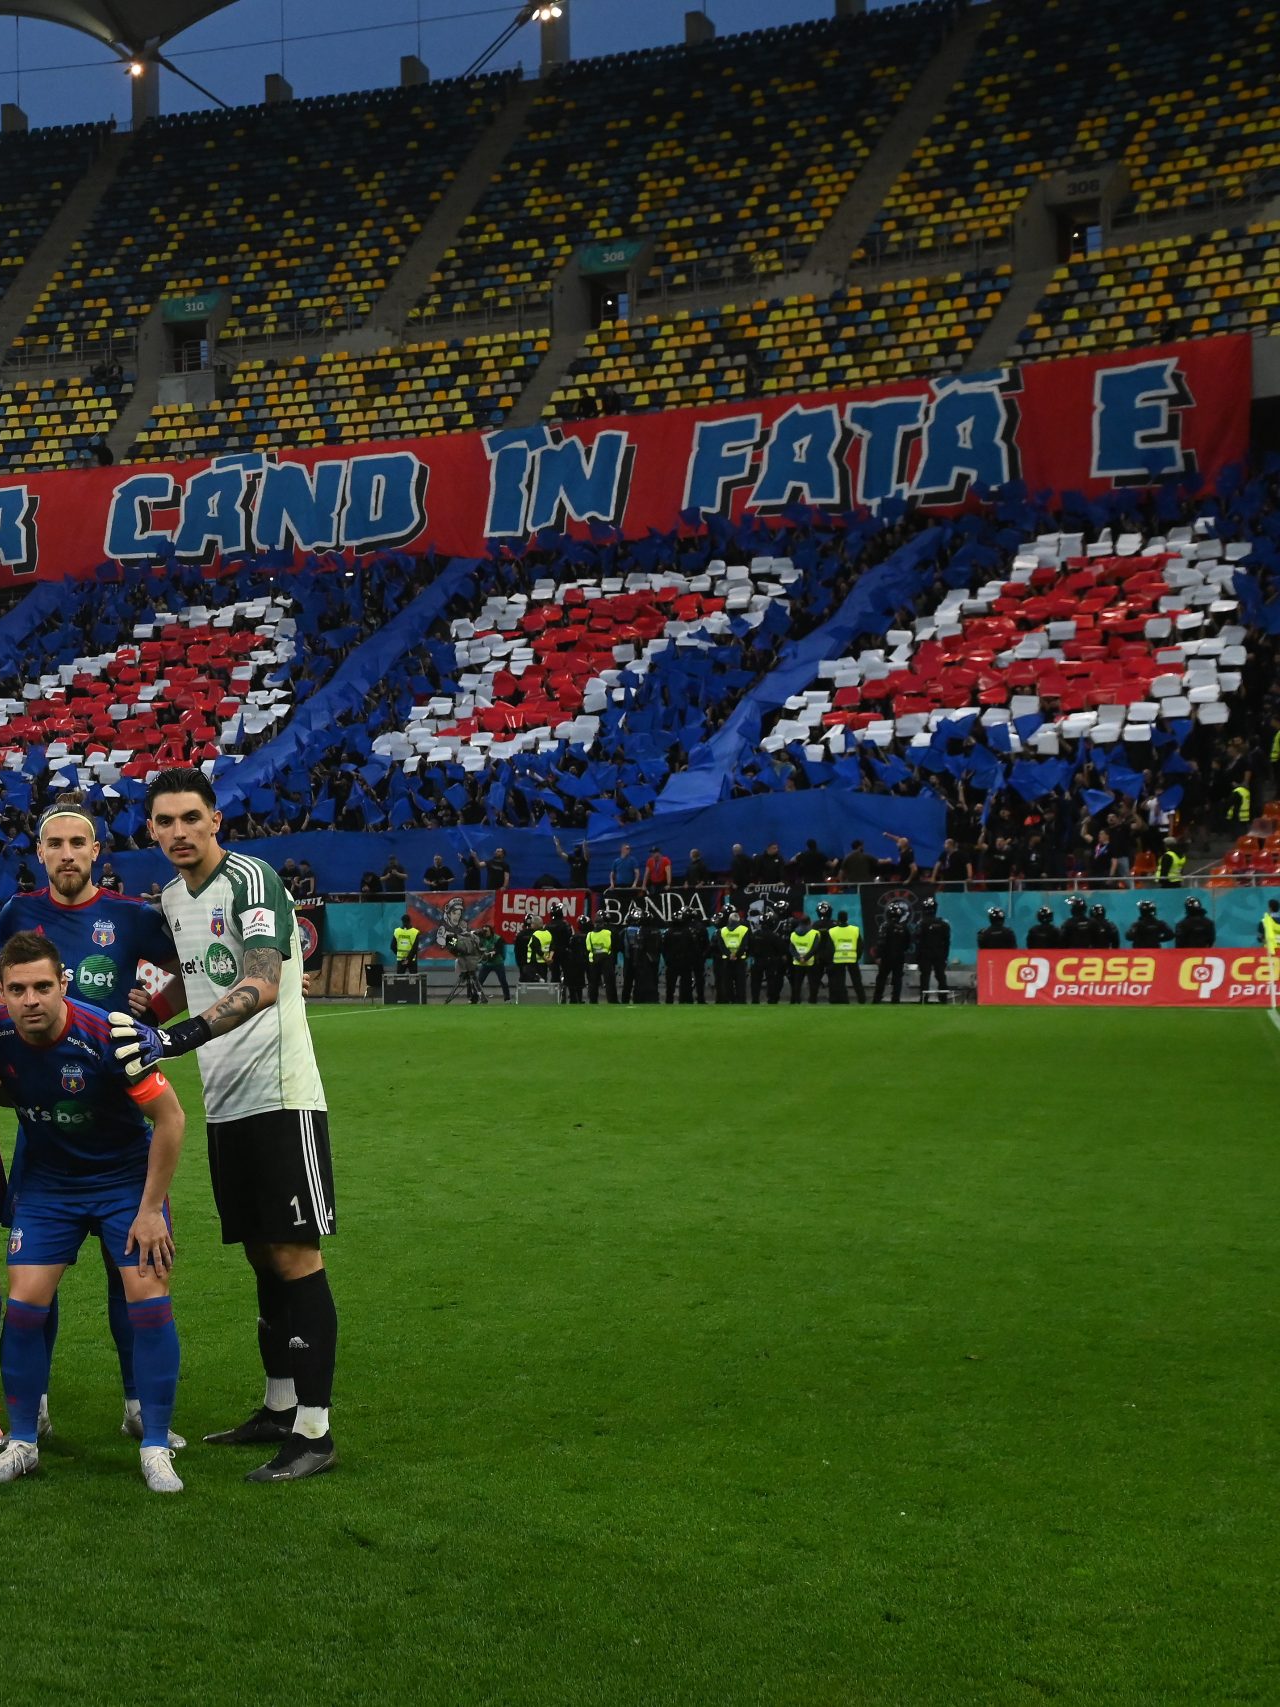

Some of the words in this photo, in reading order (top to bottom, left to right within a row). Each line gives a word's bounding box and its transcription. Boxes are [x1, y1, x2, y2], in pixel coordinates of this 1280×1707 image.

[602, 251, 625, 262] 308
[184, 302, 205, 312] 310
[1090, 357, 1194, 487] E
[294, 896, 325, 907] OSTIL
[502, 893, 577, 917] LEGION
[604, 892, 708, 925] BANDA
[502, 920, 525, 934] CSK
[181, 955, 205, 979] et's
[209, 952, 235, 976] bet
[1055, 957, 1156, 982] casa
[79, 966, 114, 988] bet
[1052, 981, 1152, 999] pariurilor
[57, 1109, 95, 1124] bet
[289, 1195, 307, 1226] 1
